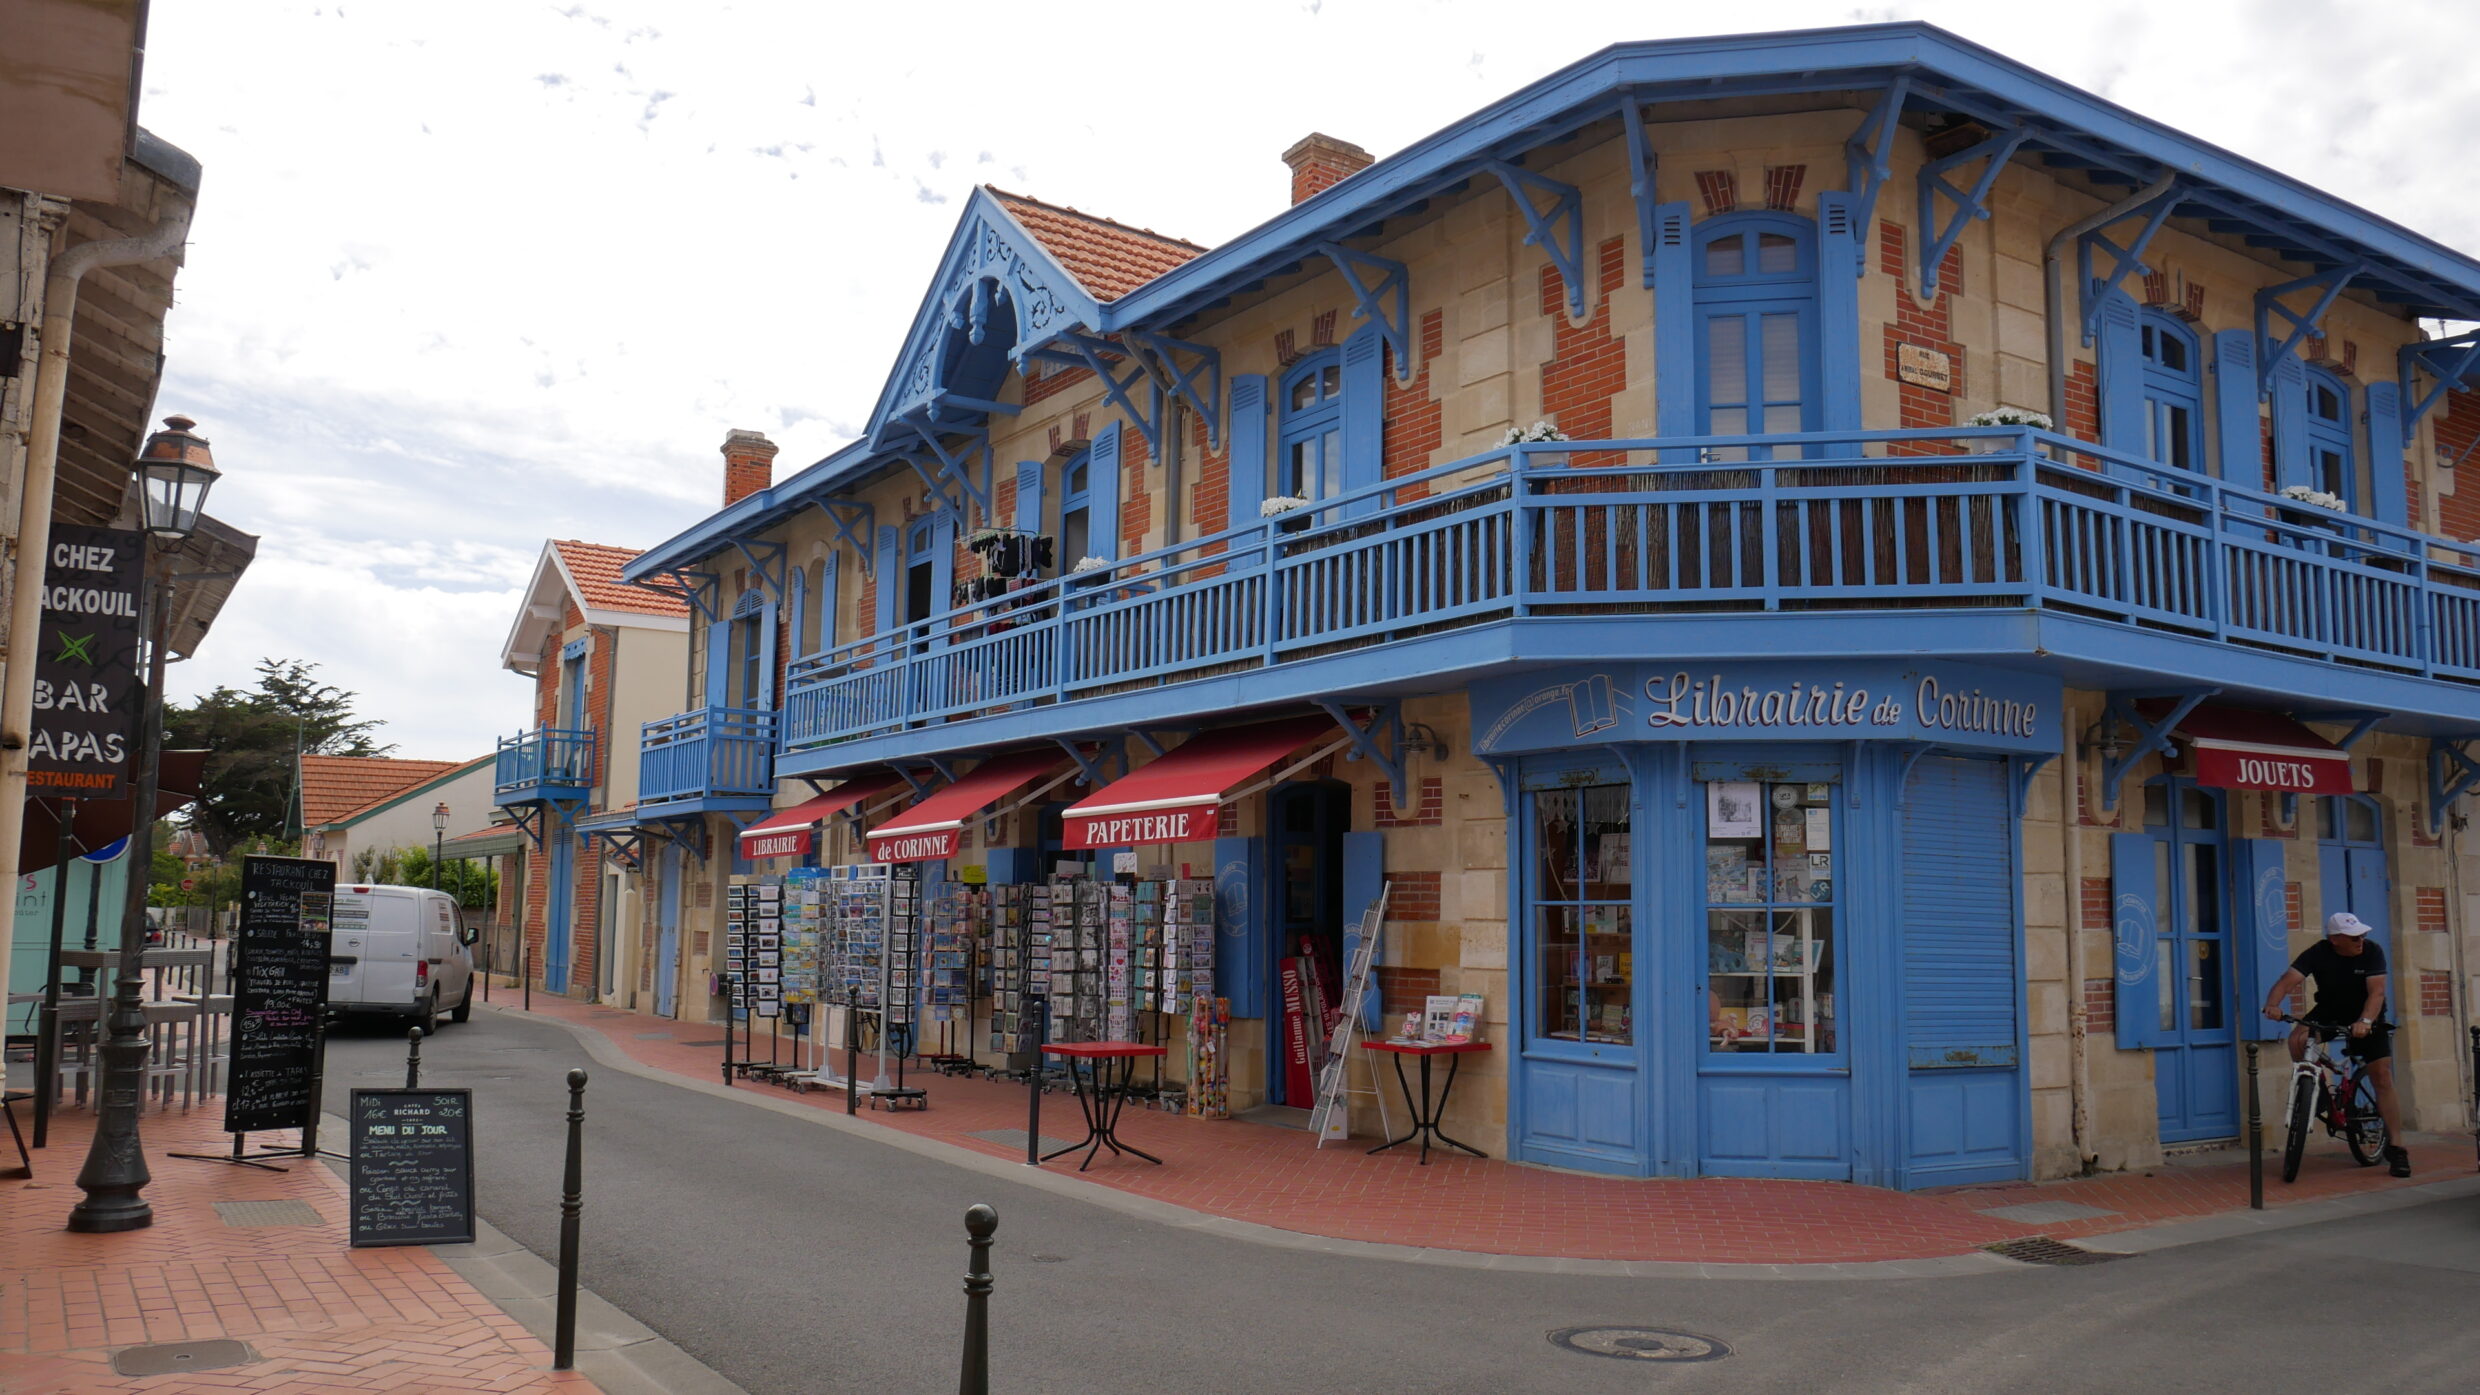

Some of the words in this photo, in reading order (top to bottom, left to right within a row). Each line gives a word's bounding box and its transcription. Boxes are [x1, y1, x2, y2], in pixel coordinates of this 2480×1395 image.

[53, 543, 115, 573] CHEZ
[40, 585, 137, 617] ACKOUIL
[33, 679, 110, 713] BAR
[1643, 671, 1868, 728] Librairie
[1870, 694, 1902, 727] de
[1915, 675, 2037, 739] Corinne
[28, 728, 126, 764] APAS
[26, 770, 117, 789] ESTAURANT
[2236, 758, 2315, 788] JOUETS
[1085, 813, 1190, 845] PAPETERIE
[752, 835, 798, 856] LIBRAIRIE
[877, 842, 892, 861] de
[894, 834, 950, 859] CORINNE
[252, 862, 306, 880] RESTAURANT
[308, 869, 329, 880] CHEZ
[1281, 969, 1302, 1013] MUSSO
[1291, 1015, 1306, 1065] Guillaume
[363, 1108, 387, 1120] 16€
[393, 1108, 431, 1116] RICHARD
[432, 1096, 459, 1106] SOIR
[438, 1107, 464, 1118] 20€
[368, 1125, 396, 1136] MENU
[401, 1125, 415, 1135] DU
[420, 1125, 448, 1135] JOUR
[420, 1168, 440, 1176] curry
